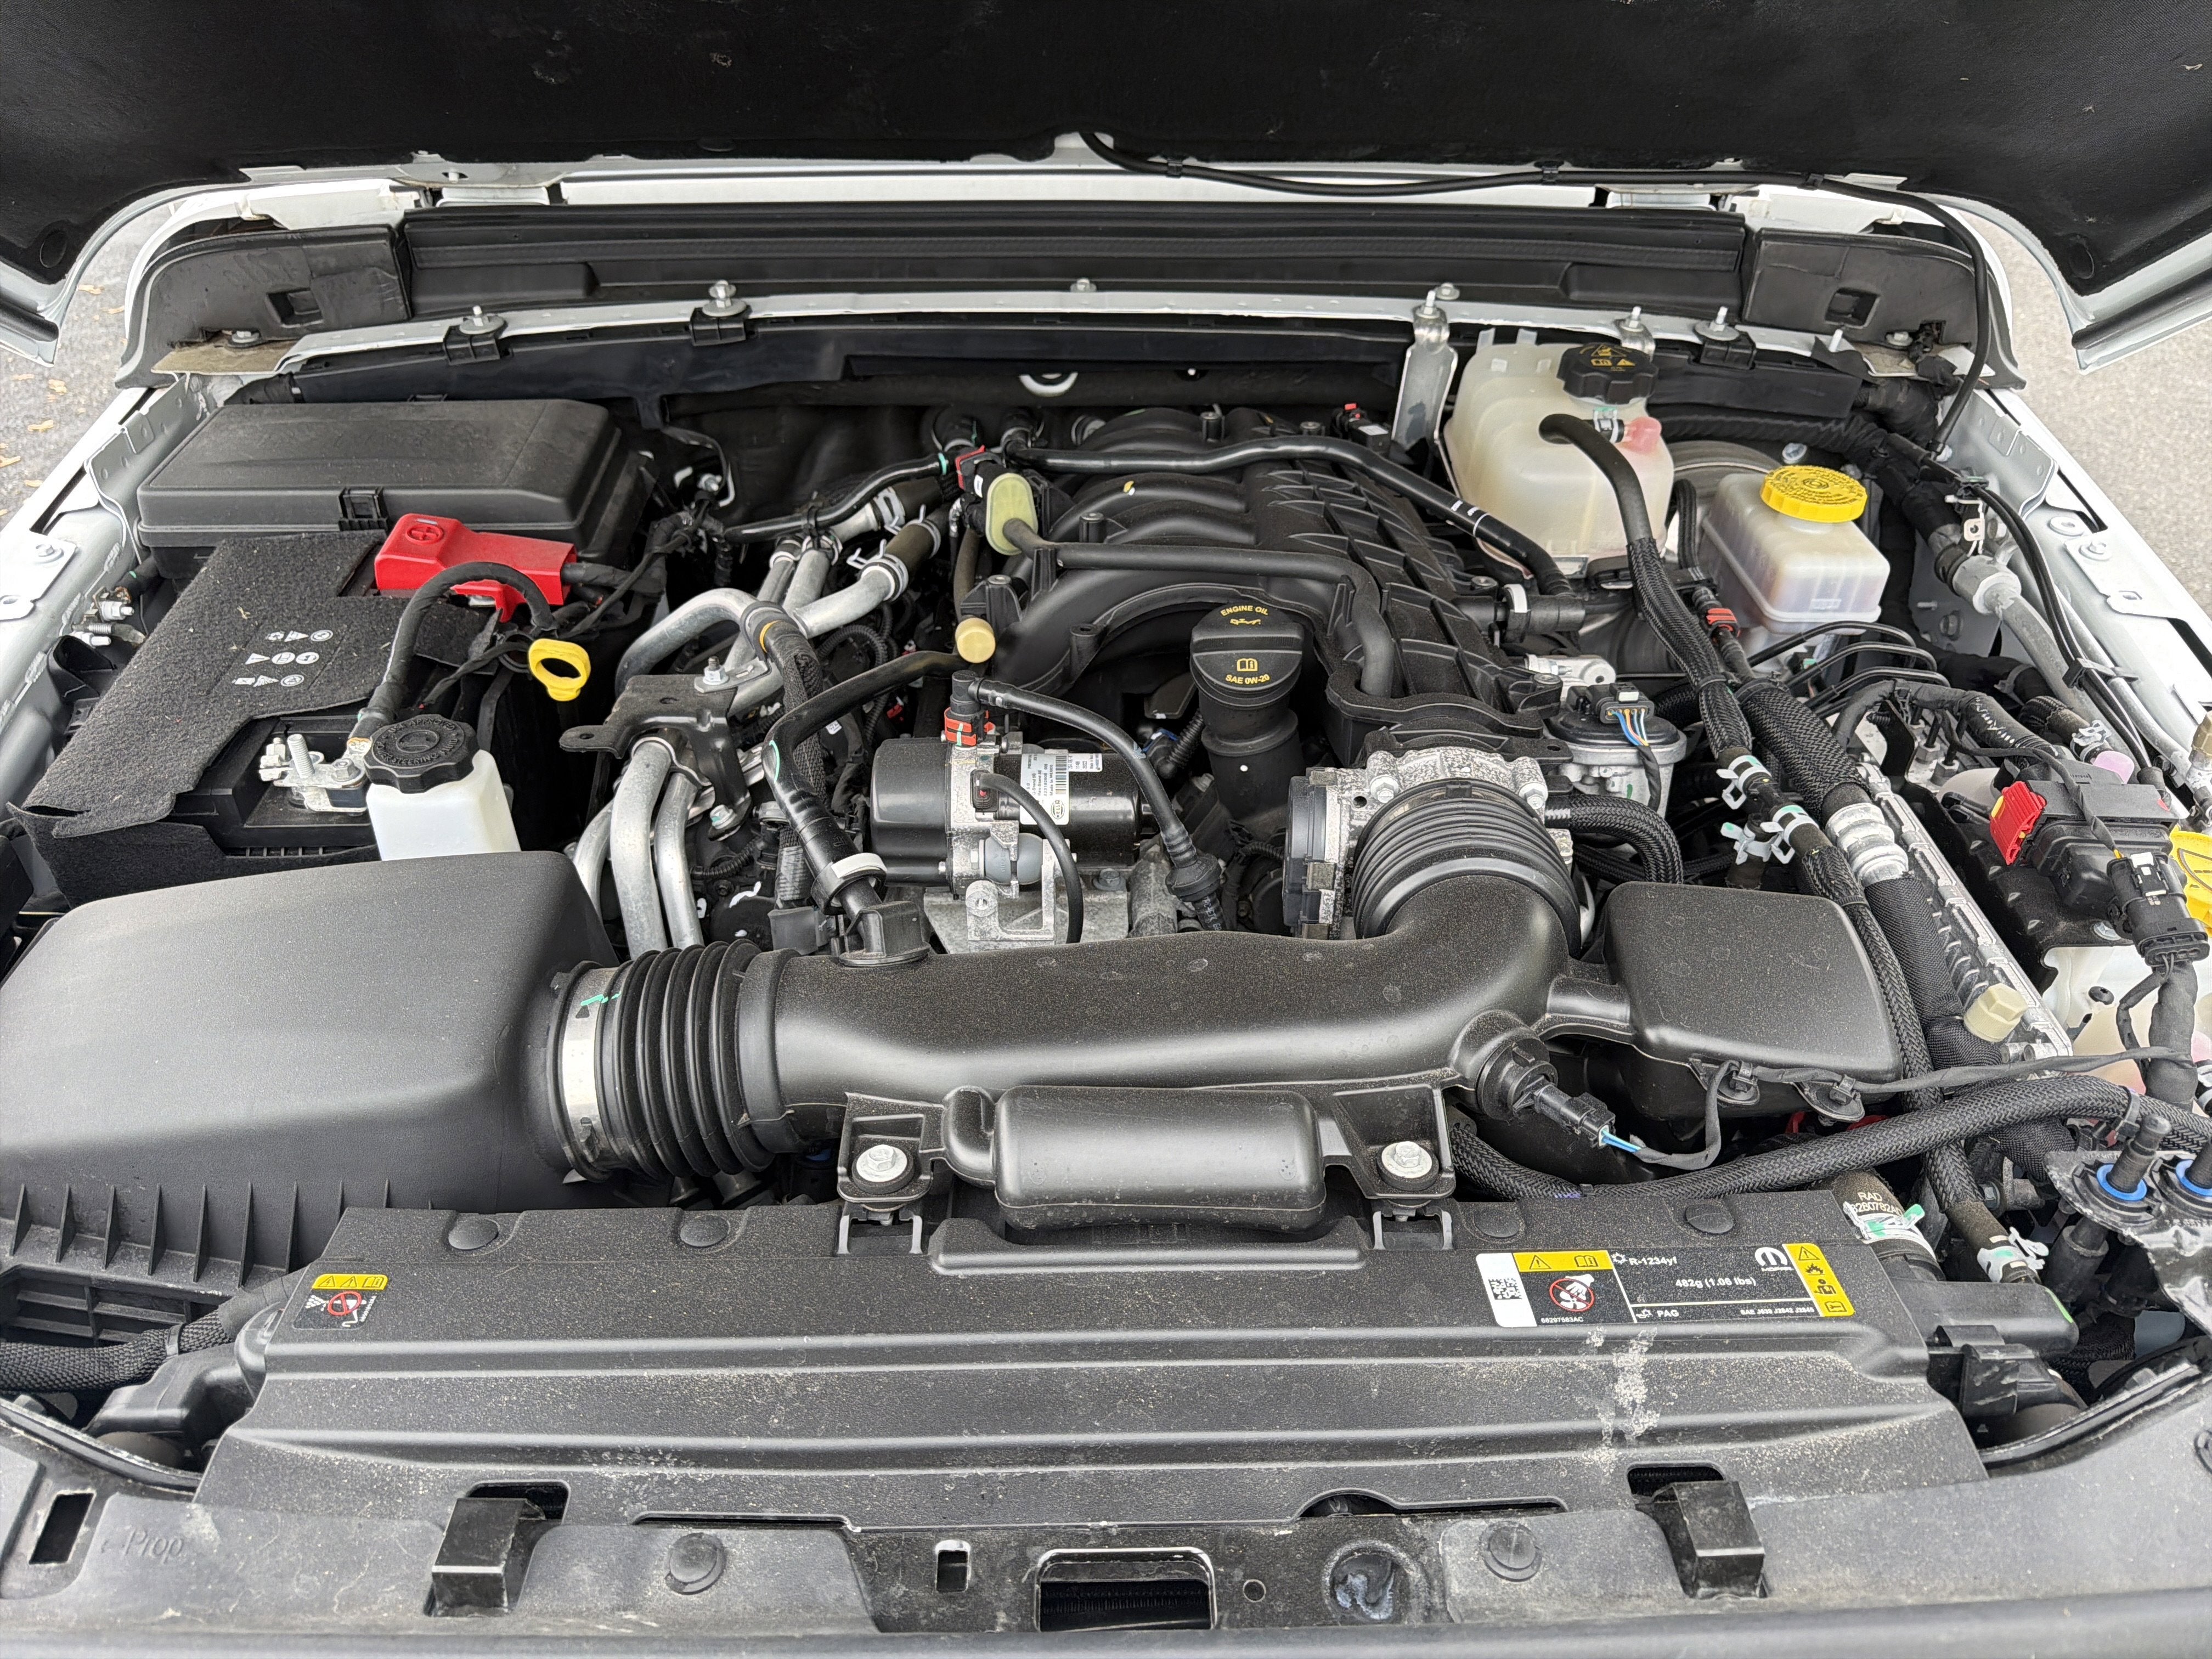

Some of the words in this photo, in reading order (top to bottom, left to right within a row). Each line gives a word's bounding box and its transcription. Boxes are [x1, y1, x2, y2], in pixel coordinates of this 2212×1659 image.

[1220, 605, 1254, 616] ENGINE
[1255, 606, 1269, 616] OIL
[1225, 674, 1244, 685] SAE
[1244, 674, 1270, 685] 0W-20
[392, 752, 438, 765] STEERING
[1857, 1192, 1883, 1201] RAD
[1628, 1256, 1678, 1266] R-1234yf
[1675, 1278, 1703, 1288] 482g
[1705, 1277, 1733, 1288] (1.06
[1734, 1276, 1757, 1286] lbs)
[1656, 1309, 1679, 1318] PAG
[125, 1527, 184, 1564] Prop
